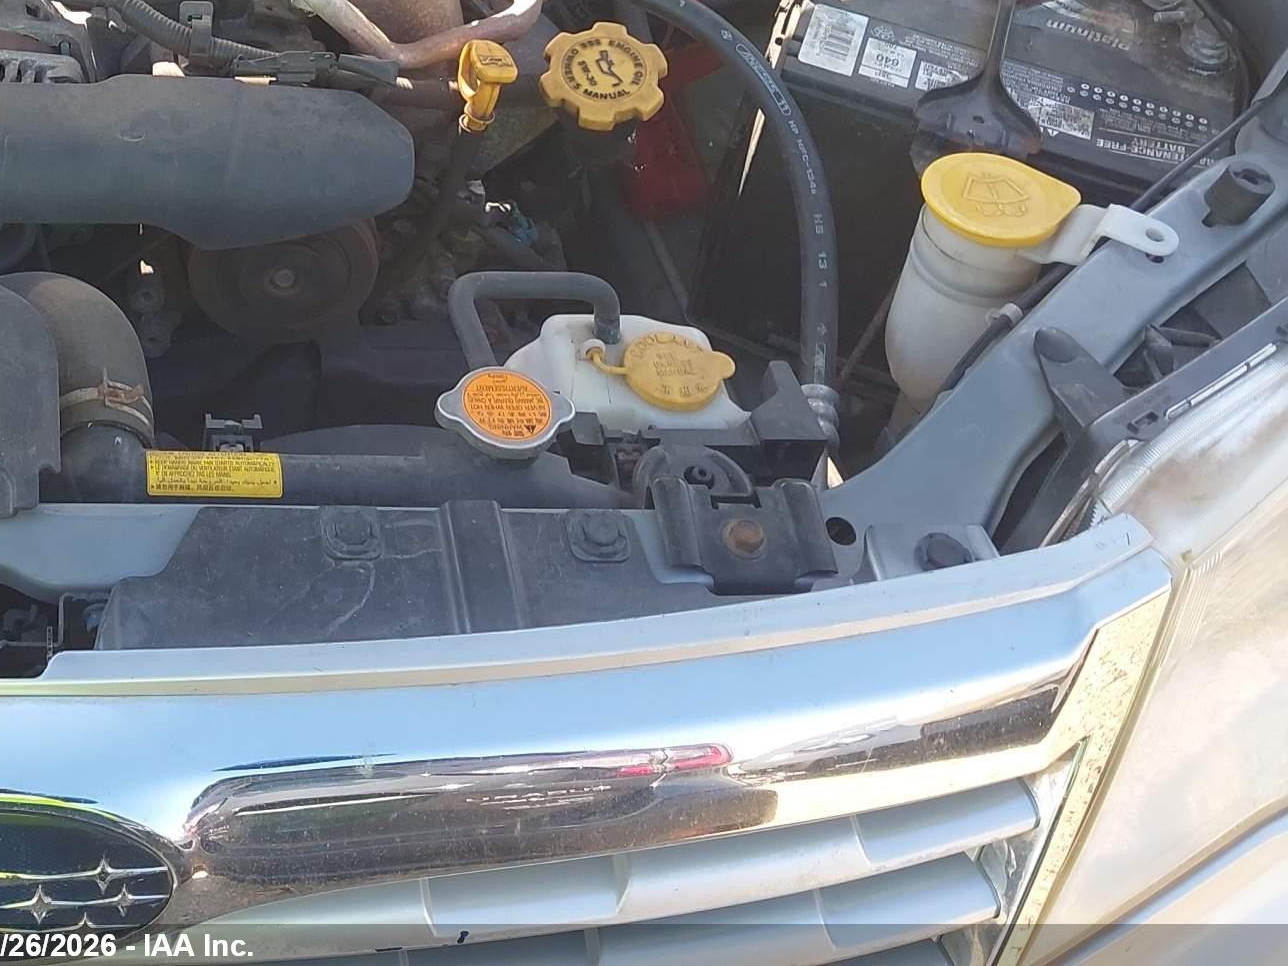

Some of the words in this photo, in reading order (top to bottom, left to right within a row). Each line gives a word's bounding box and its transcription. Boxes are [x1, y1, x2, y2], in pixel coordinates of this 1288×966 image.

[1045, 19, 1131, 51] Platinum
[580, 39, 602, 49] SEE
[608, 40, 643, 68] ENGINE
[629, 70, 644, 86] OIL
[876, 53, 899, 67] 640
[582, 88, 631, 100] MANUAL
[1131, 137, 1187, 154] BATTERY
[818, 251, 828, 269] 13
